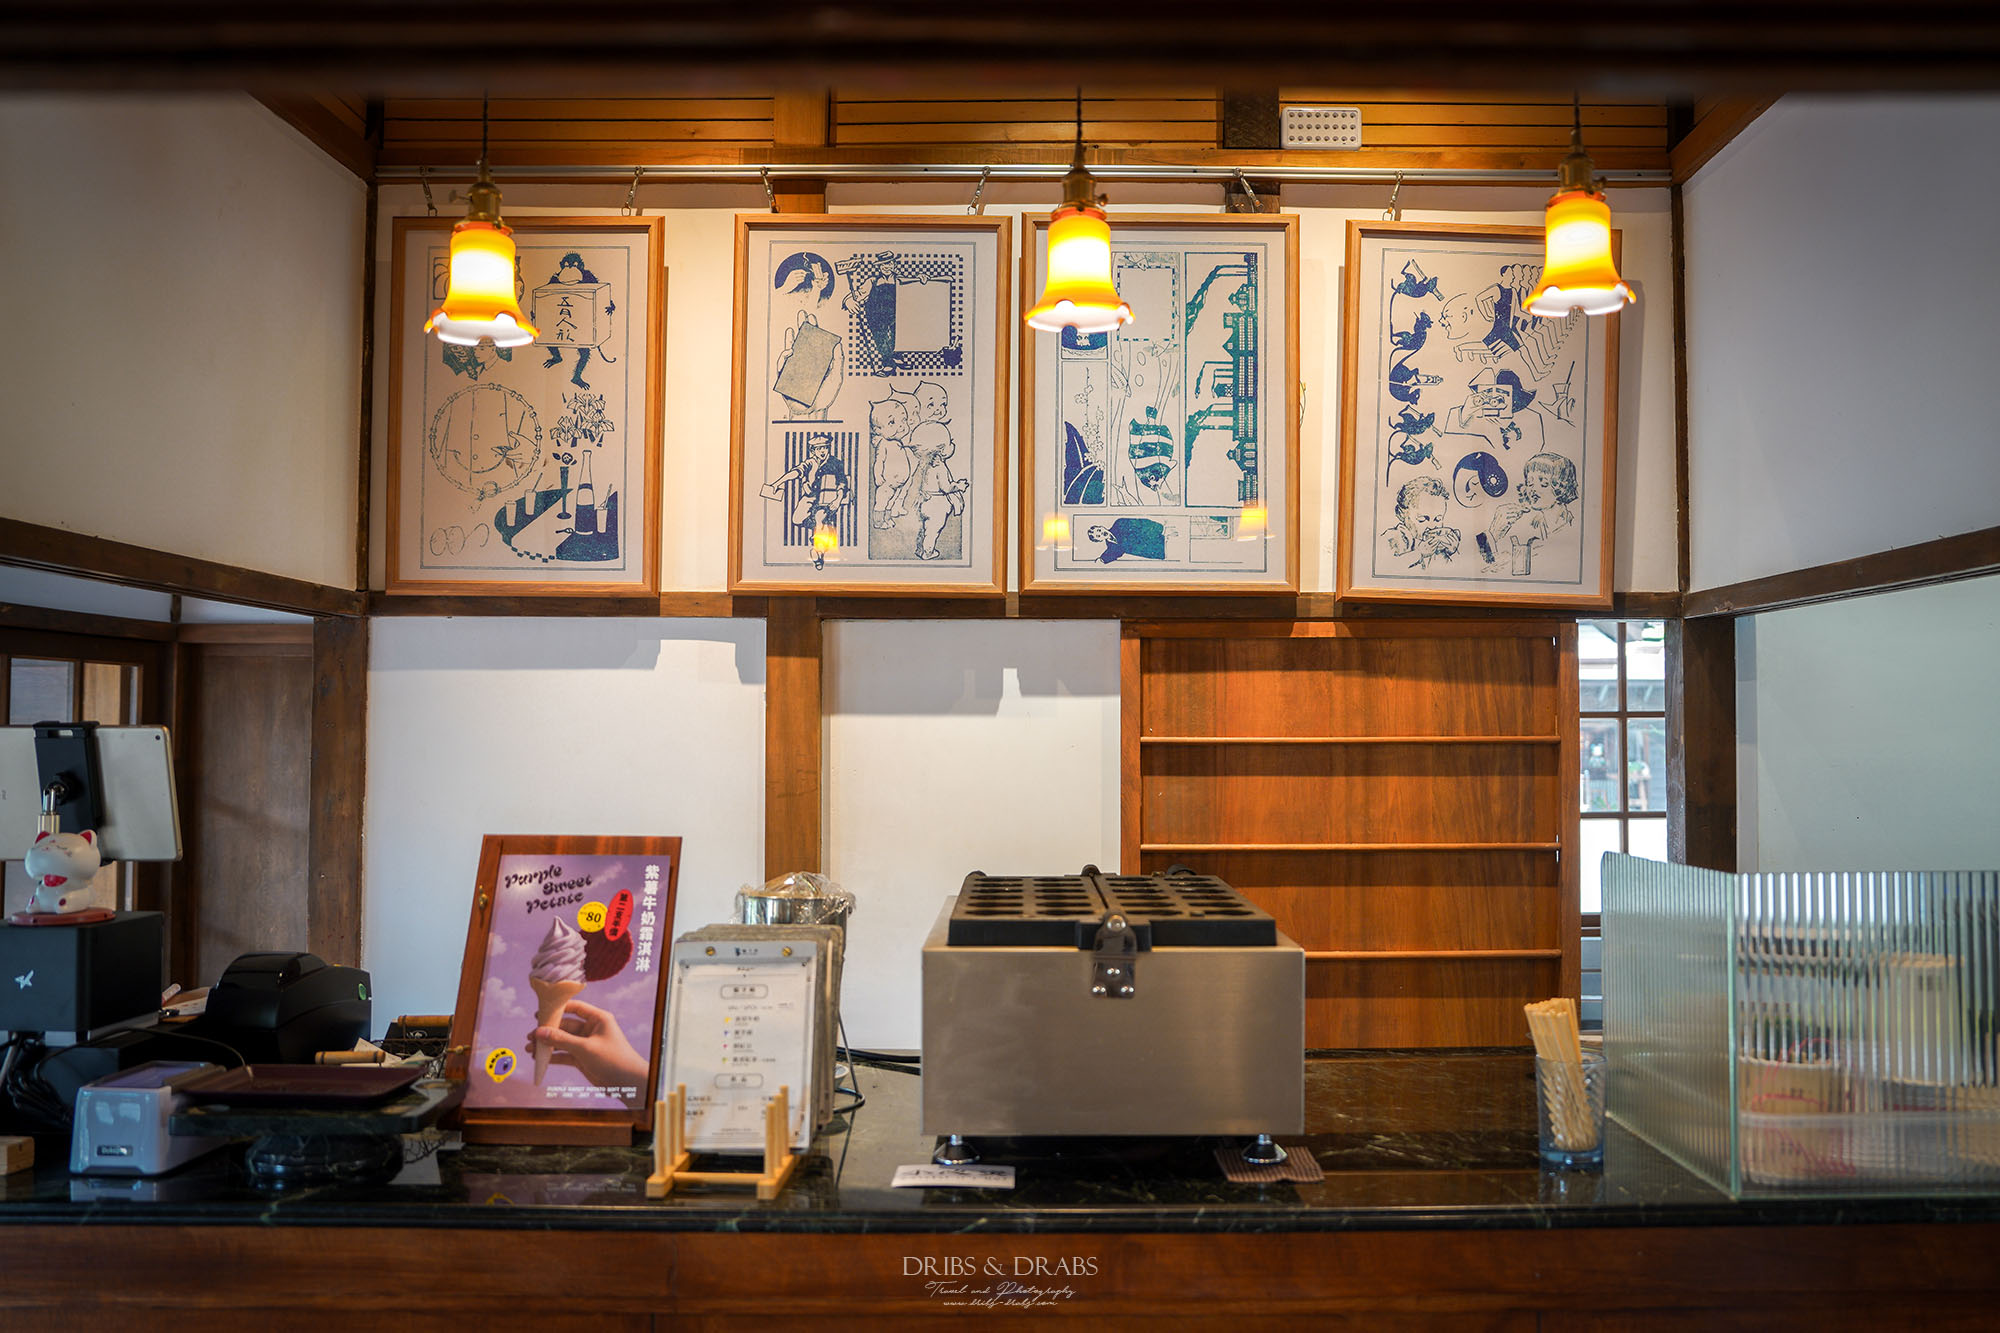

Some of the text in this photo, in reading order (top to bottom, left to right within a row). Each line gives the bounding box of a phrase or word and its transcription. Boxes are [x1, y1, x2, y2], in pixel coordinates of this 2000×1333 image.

[555, 296, 578, 342] 五月人形
[586, 911, 602, 922] 80
[635, 864, 660, 972] 紫薯牛奶霜淇淋
